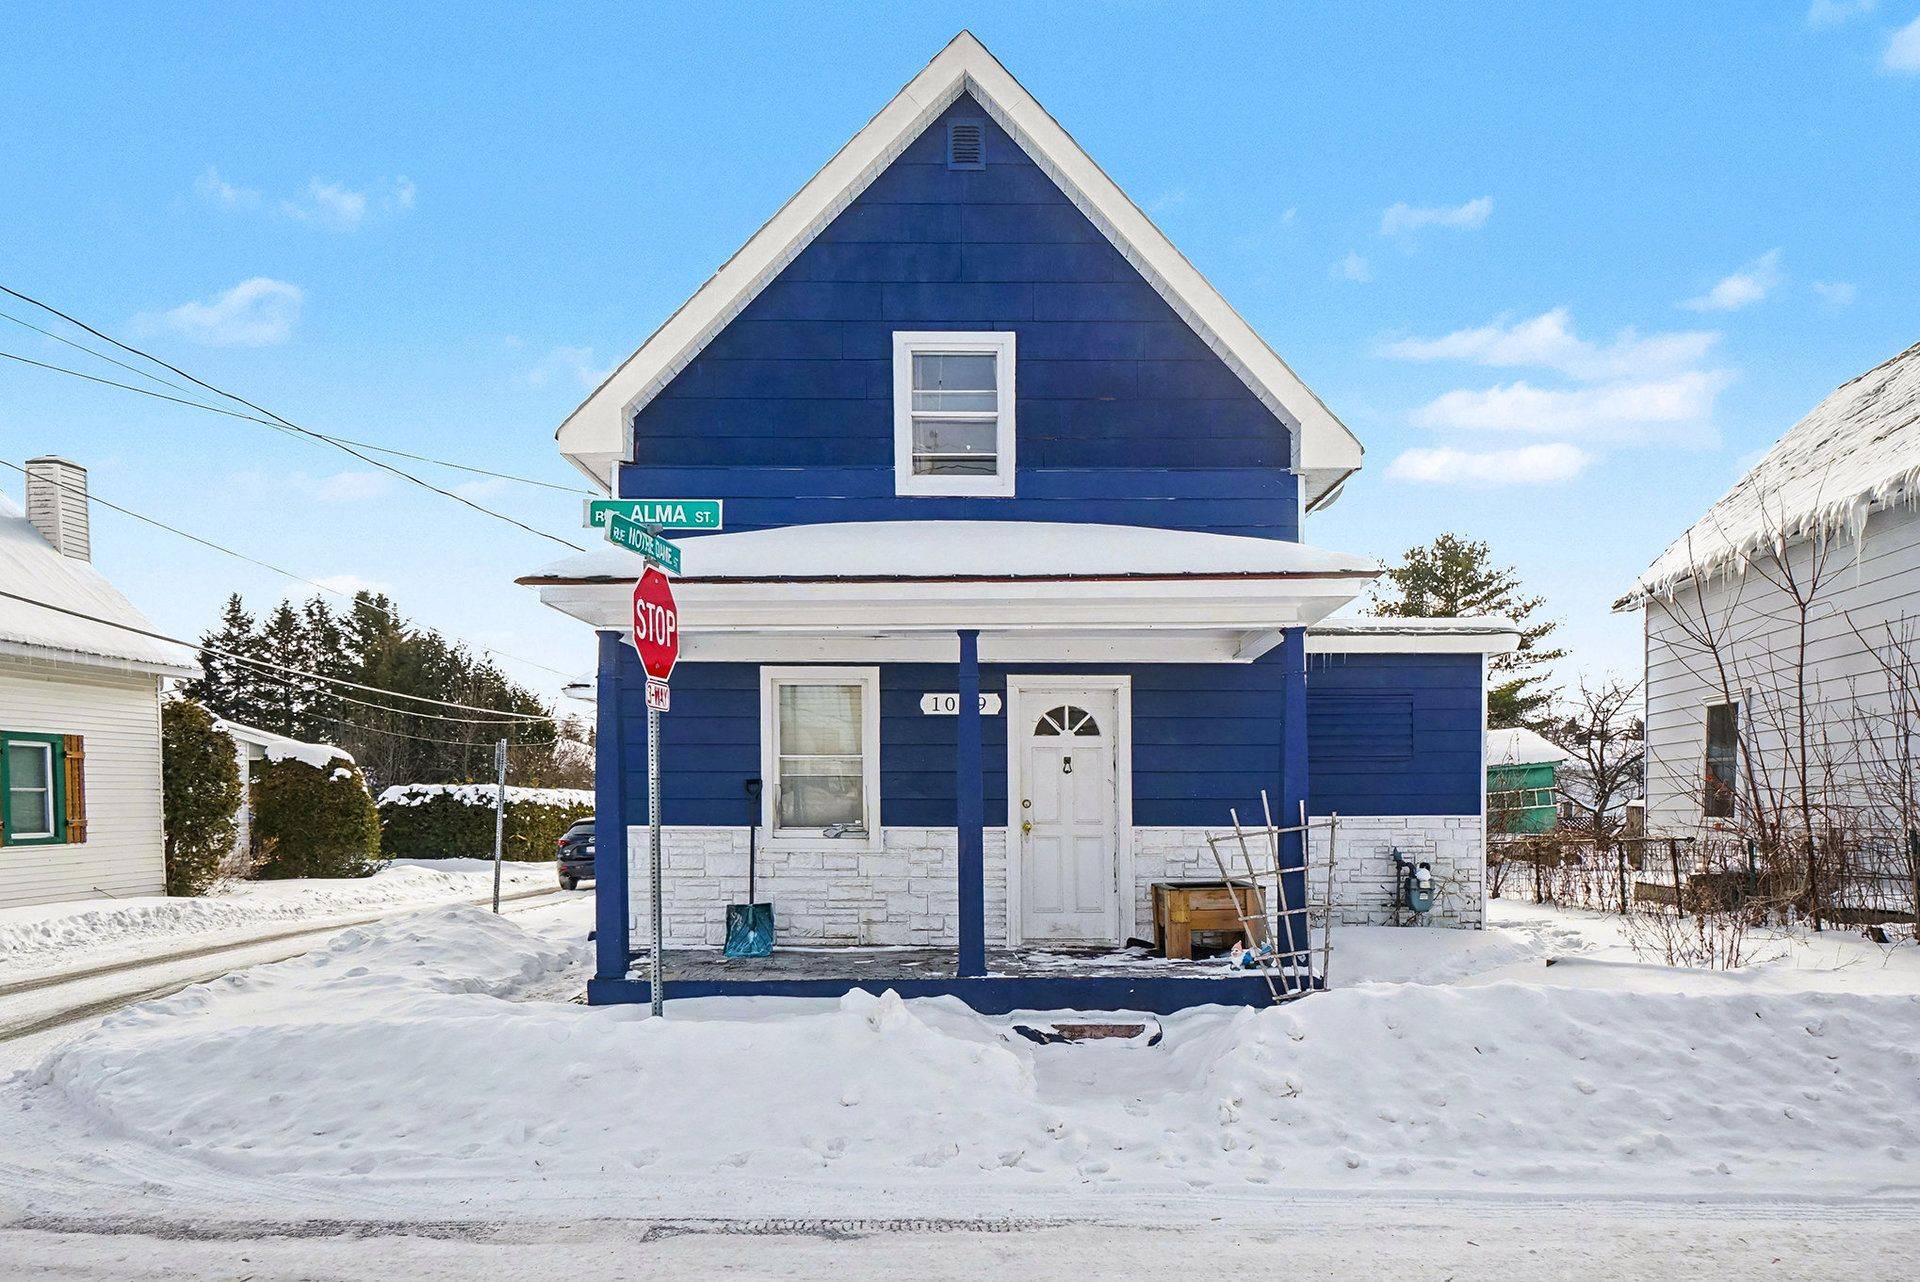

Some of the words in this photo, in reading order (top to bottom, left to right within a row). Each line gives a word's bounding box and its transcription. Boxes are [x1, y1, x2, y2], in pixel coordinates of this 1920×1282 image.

[631, 505, 687, 523] ALMA
[695, 511, 714, 523] ST.
[636, 599, 676, 647] STOP
[647, 684, 669, 707] 3-WAY
[932, 696, 987, 712] 109
